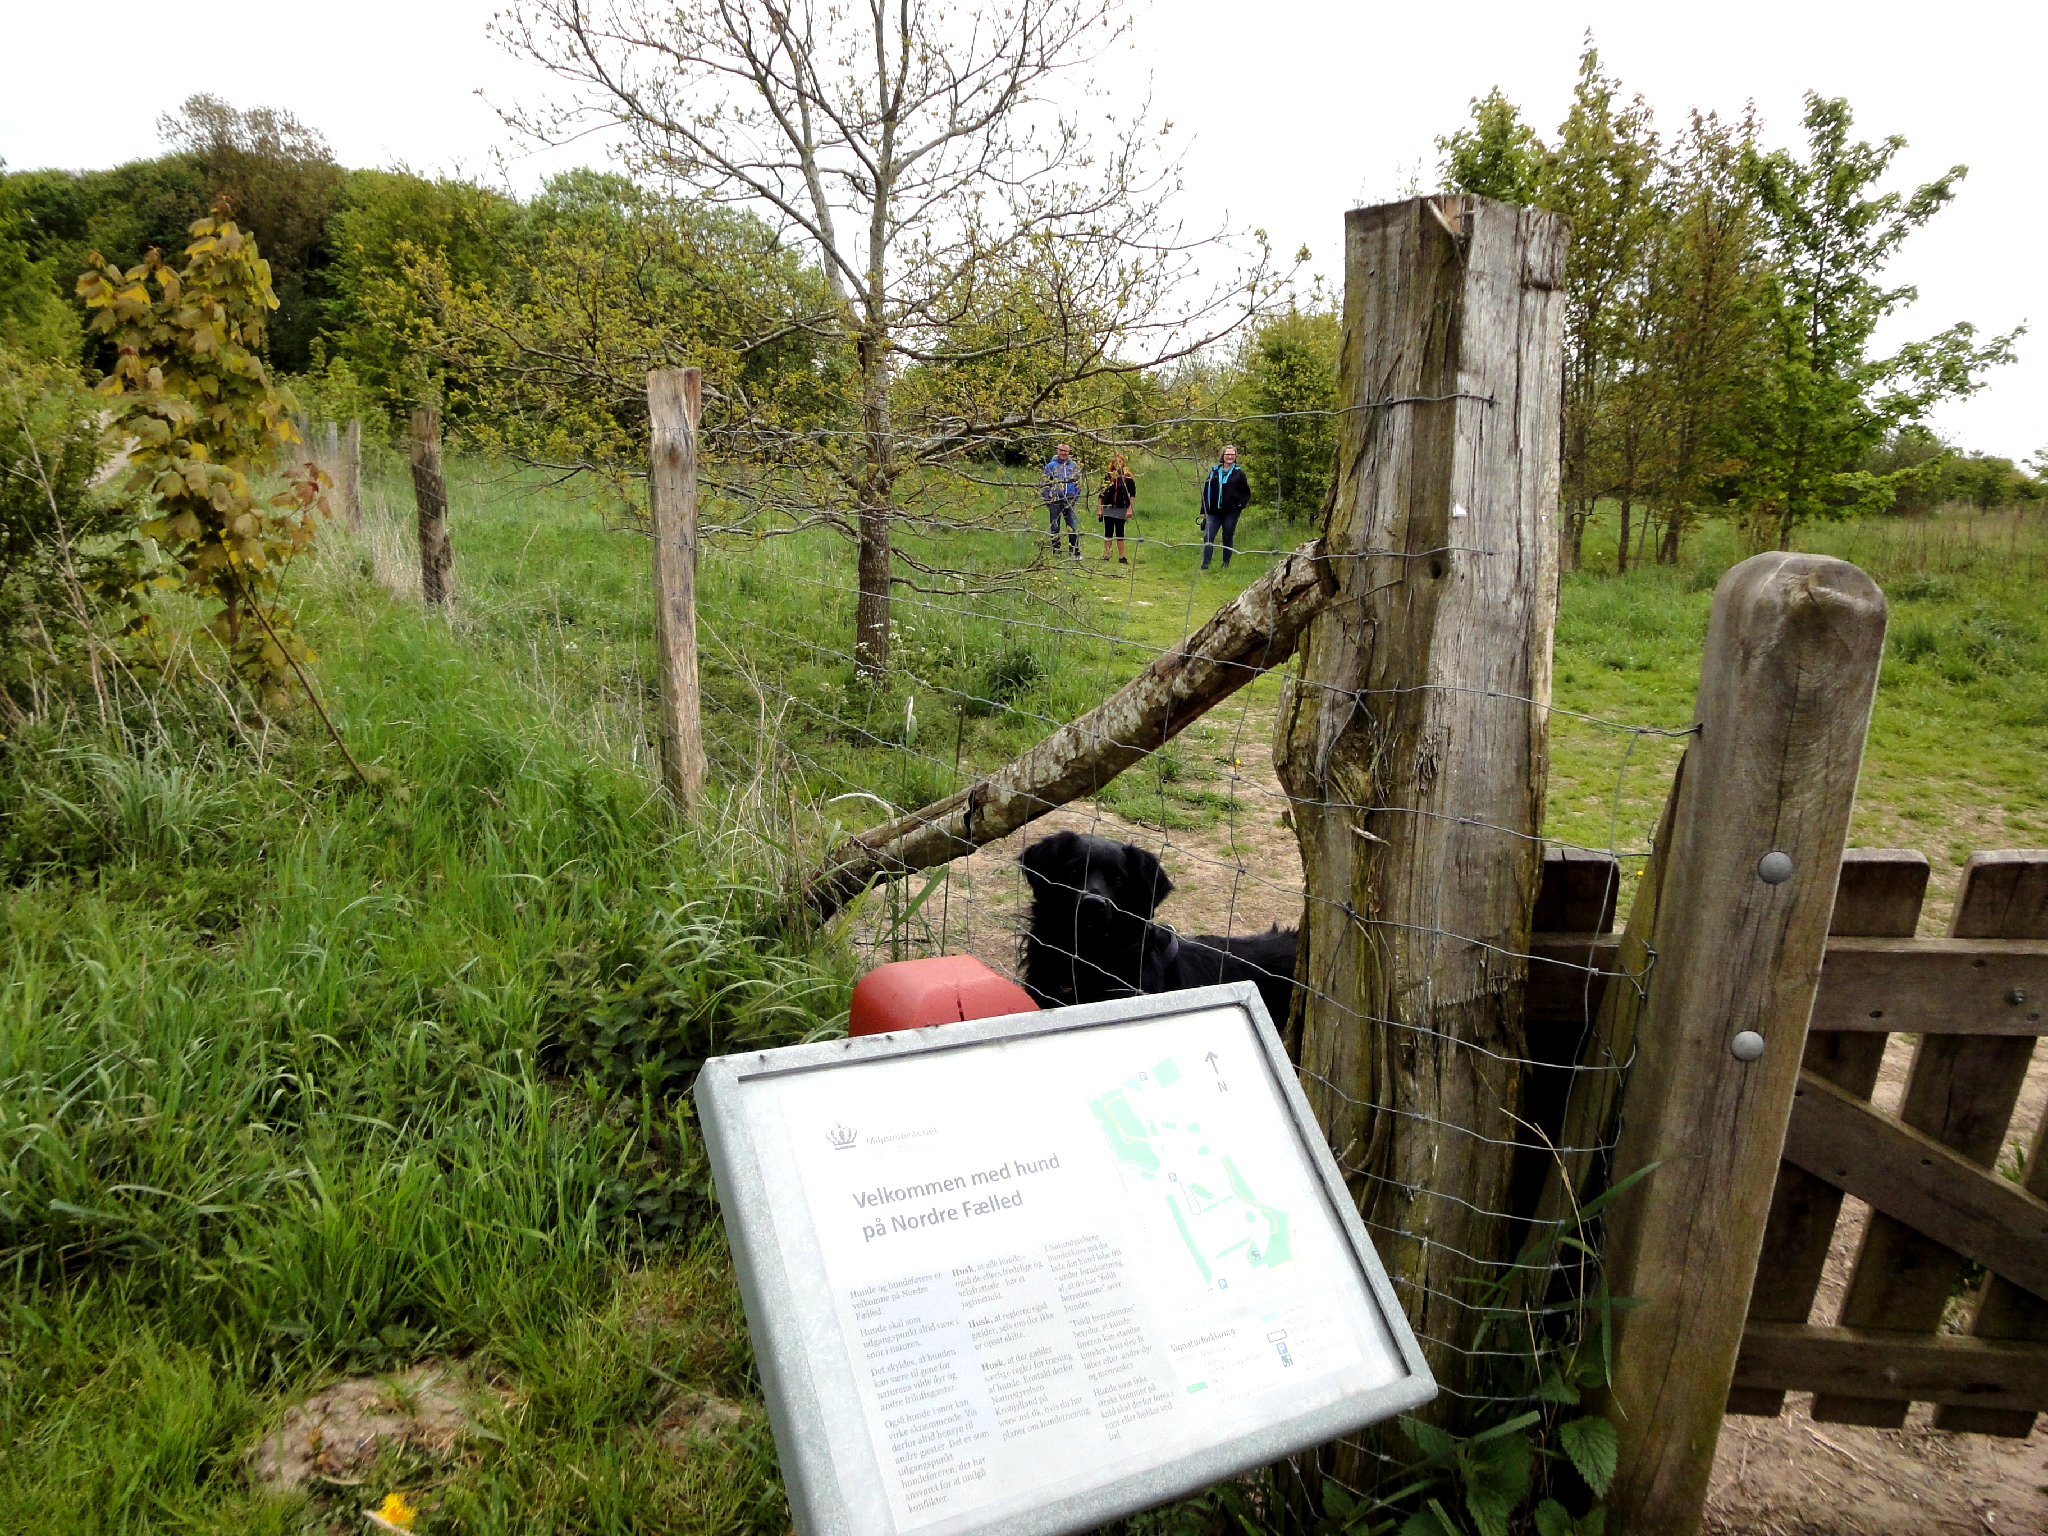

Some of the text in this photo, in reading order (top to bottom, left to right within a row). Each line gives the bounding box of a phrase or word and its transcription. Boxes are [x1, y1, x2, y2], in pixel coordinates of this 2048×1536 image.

[1218, 1081, 1228, 1092] N
[852, 1153, 1060, 1208] Velkommen med hund
[862, 1190, 1023, 1243] på Nordre Fælled
